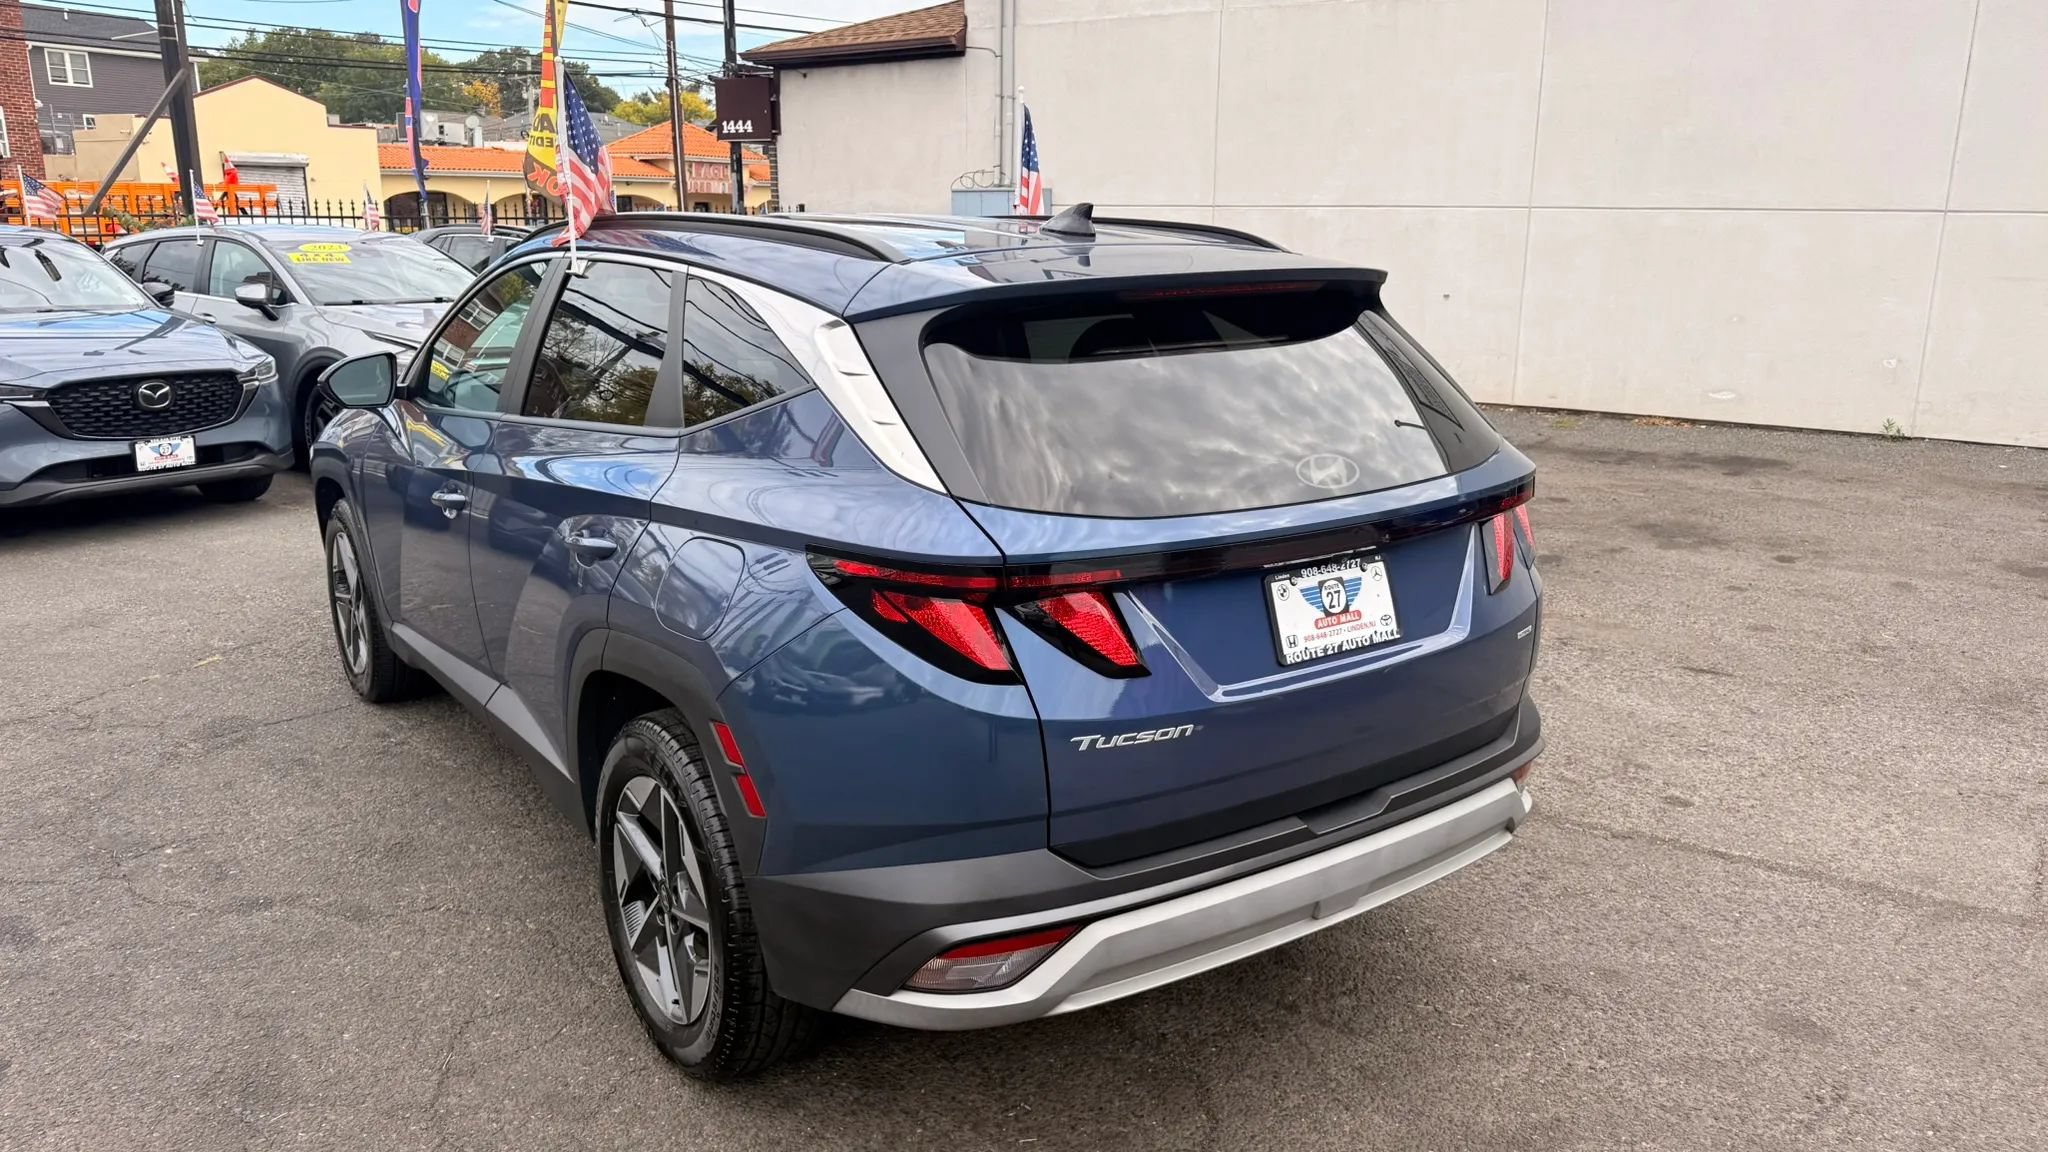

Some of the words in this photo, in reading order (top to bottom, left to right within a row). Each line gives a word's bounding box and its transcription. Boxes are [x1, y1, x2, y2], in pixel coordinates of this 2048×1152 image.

[721, 119, 754, 134] 1444
[1323, 583, 1341, 591] ROUTE
[1326, 589, 1341, 610] 27
[1317, 617, 1338, 629] AUTO
[1340, 611, 1360, 622] MALL
[1286, 647, 1325, 665] ROUTE
[1326, 643, 1339, 656] 27
[1341, 635, 1371, 652] AUTO
[1371, 629, 1401, 644] MALL
[1070, 724, 1194, 751] Tucson
